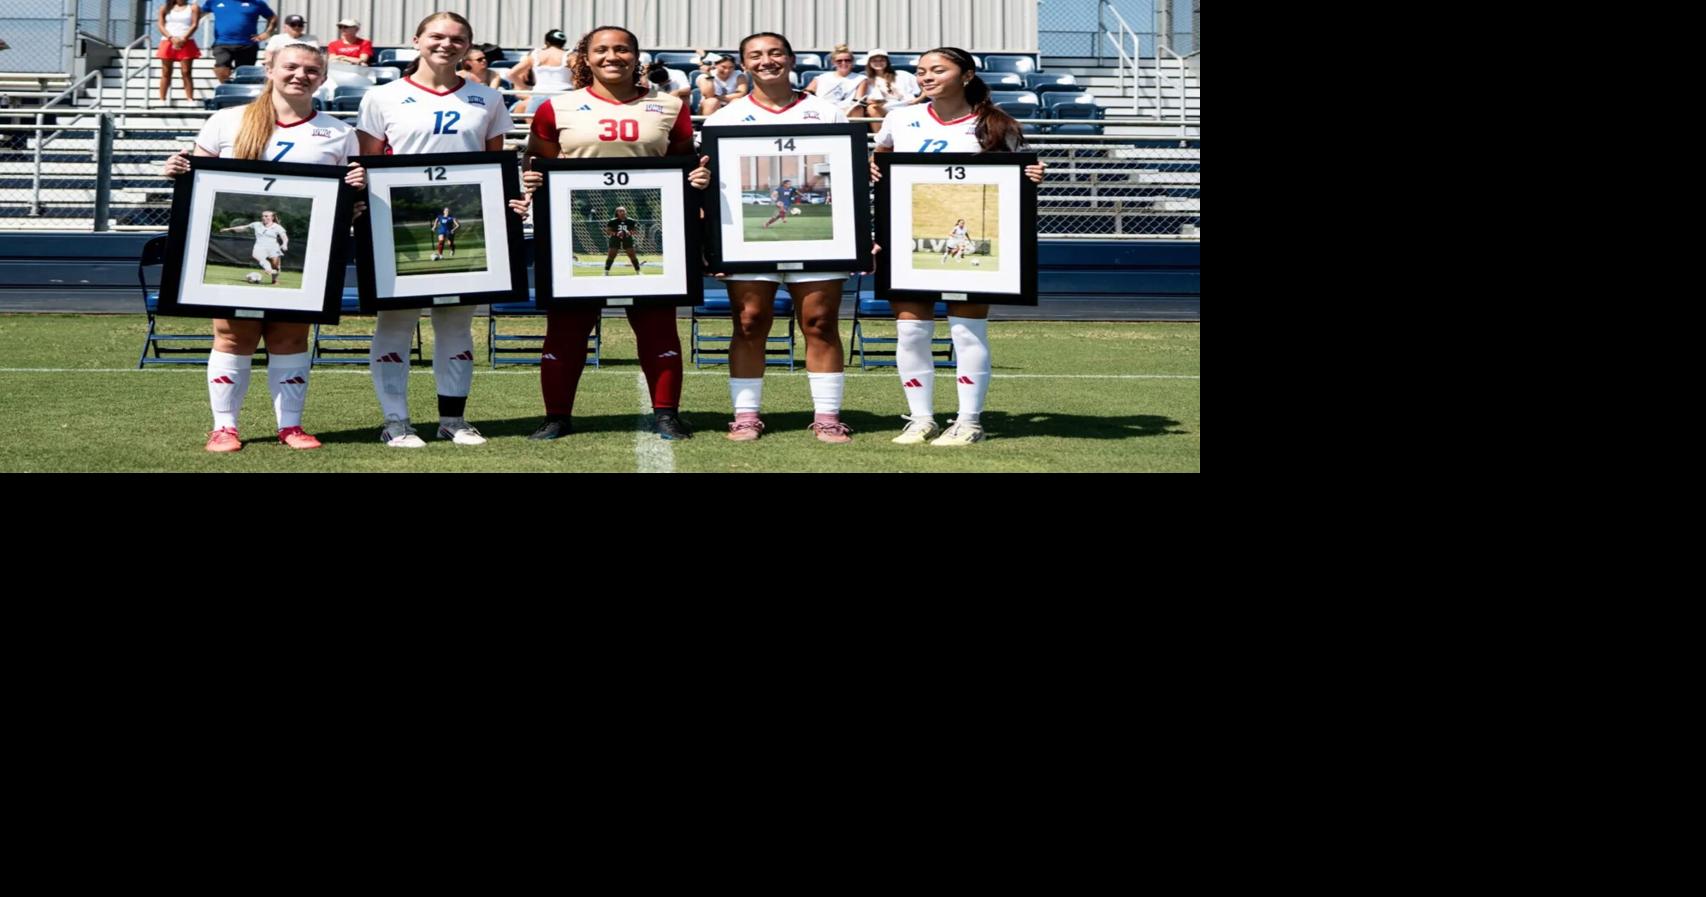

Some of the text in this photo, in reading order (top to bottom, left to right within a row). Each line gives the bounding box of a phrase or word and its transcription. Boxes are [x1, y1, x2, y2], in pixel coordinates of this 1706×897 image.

[433, 111, 460, 135] 12
[598, 119, 639, 142] 30
[272, 141, 295, 161] 7
[774, 138, 796, 152] 14
[424, 167, 447, 181] 12
[603, 172, 629, 185] 30
[945, 166, 966, 179] 13
[263, 177, 276, 191] 7
